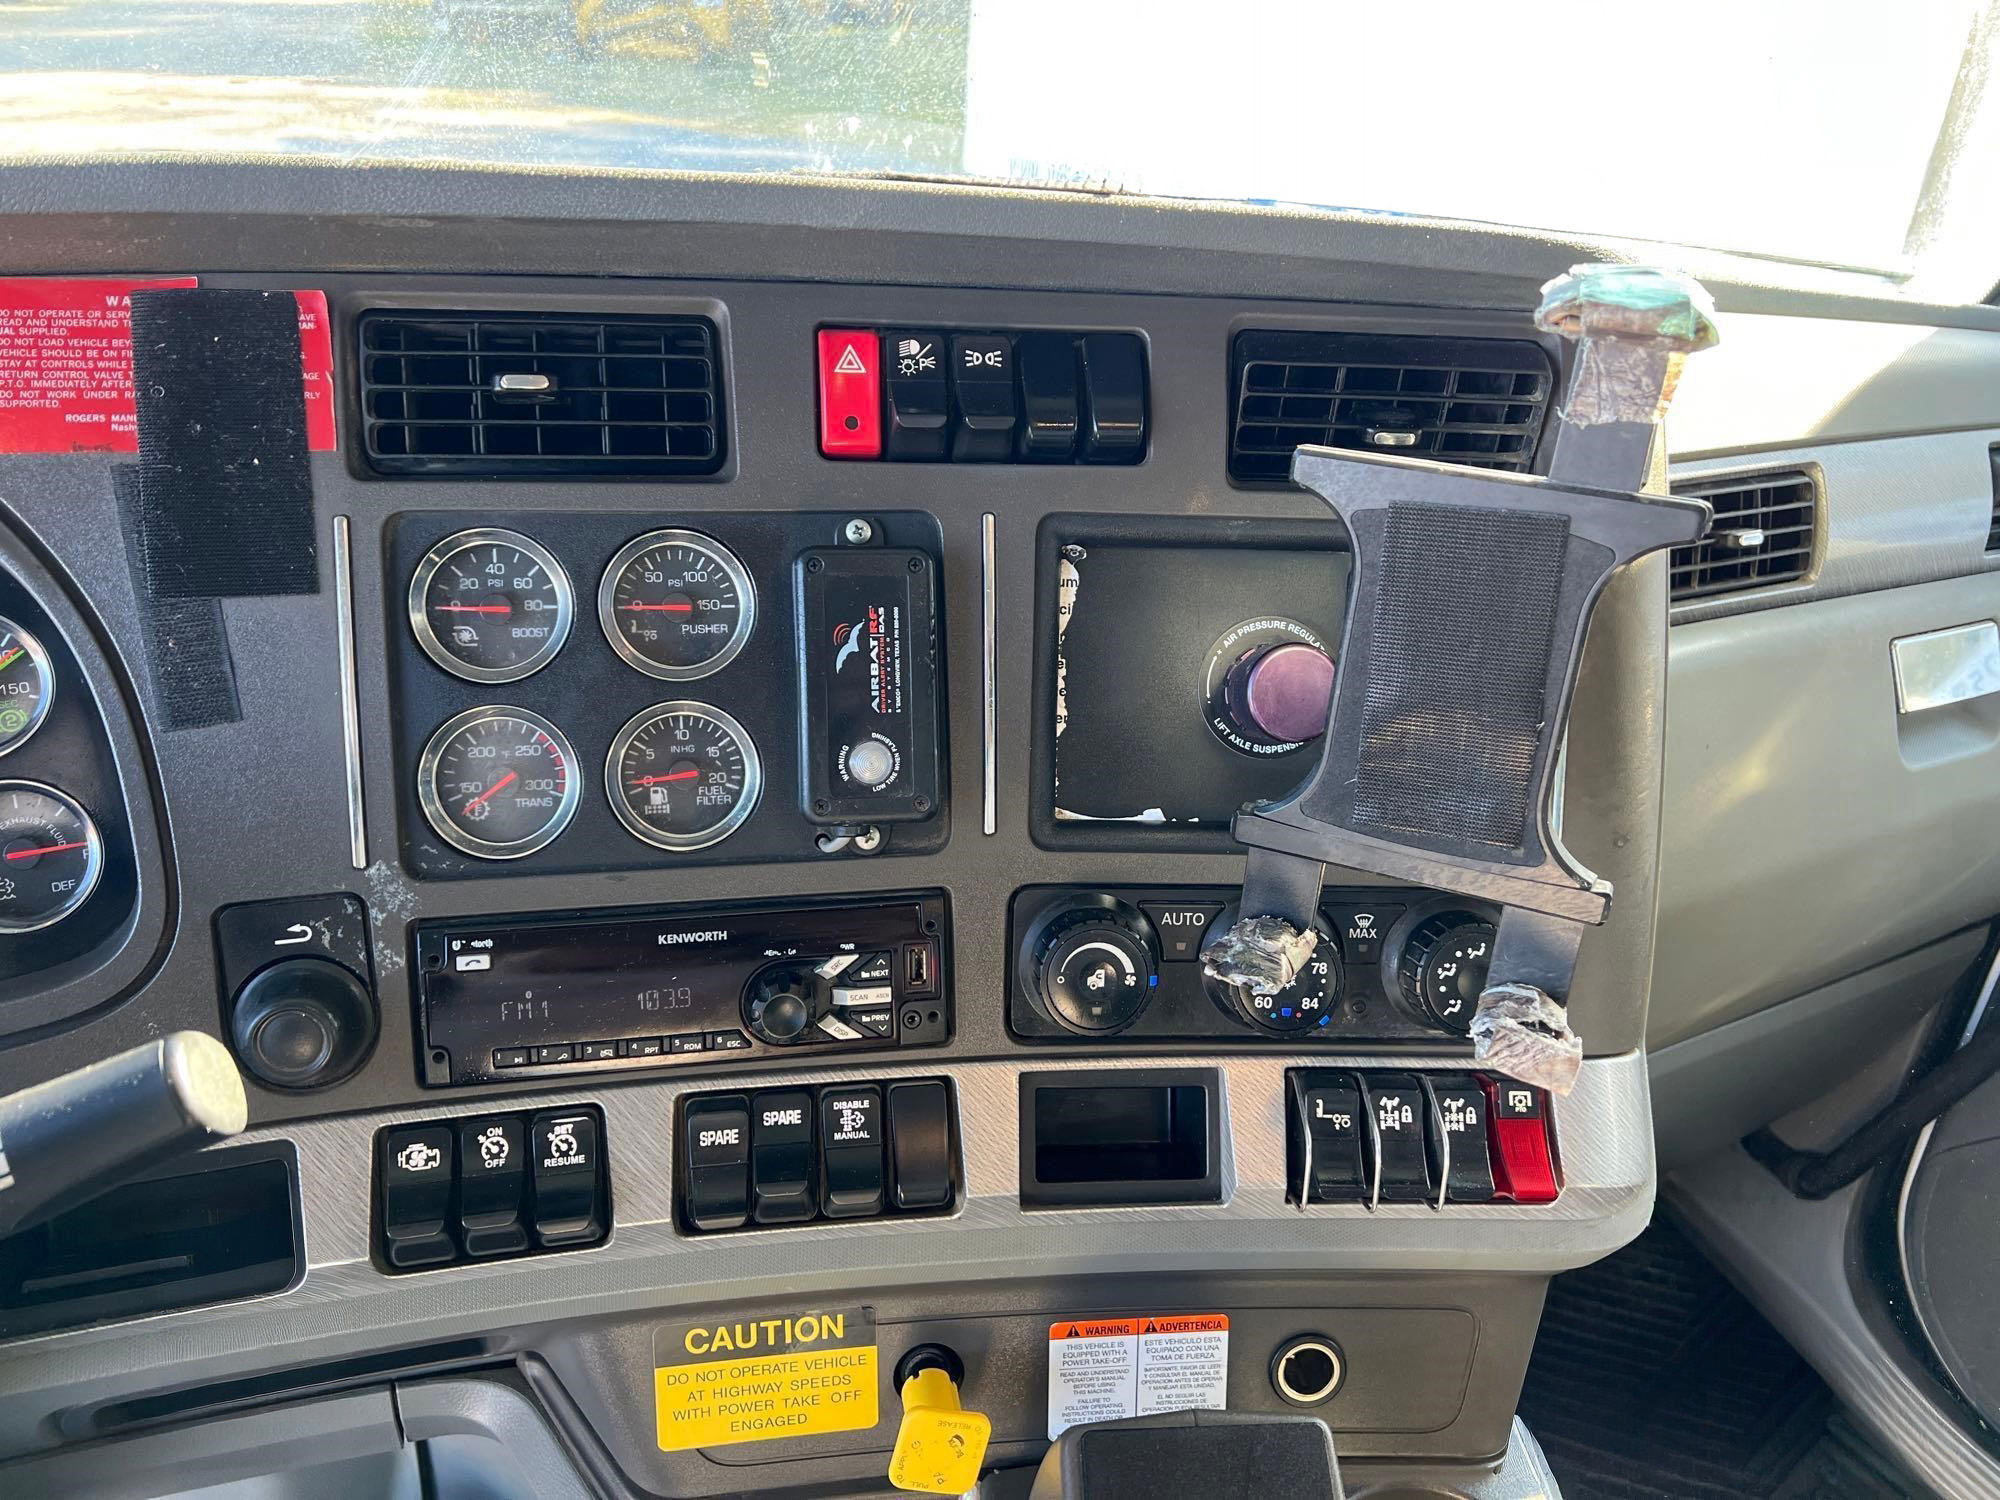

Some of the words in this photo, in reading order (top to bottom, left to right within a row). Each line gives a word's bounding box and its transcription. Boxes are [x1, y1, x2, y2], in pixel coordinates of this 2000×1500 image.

[39, 310, 84, 318] OPERATE
[51, 319, 119, 328] UNDERSTAND
[19, 328, 70, 336] SUPPLIED.
[14, 338, 33, 346] NOT
[38, 338, 64, 346] LOAD
[67, 339, 108, 347] VEHICLE
[42, 349, 82, 357] SHOULD
[41, 360, 94, 368] CONTROLS
[97, 361, 127, 369] WHILE
[43, 371, 89, 379] CONTROL
[94, 371, 123, 379] VALVE
[31, 380, 96, 388] IMMEDIATELY
[101, 380, 132, 388] AFTER
[0, 400, 61, 408] SUPPORTED.
[65, 414, 105, 422] ROGERS
[485, 563, 505, 575] 40
[644, 571, 663, 583] 50
[683, 571, 708, 583] 100
[459, 578, 479, 591] 20
[487, 579, 504, 588] PSI
[513, 577, 533, 590] 60
[668, 579, 683, 588] PSI
[524, 600, 543, 612] 80
[697, 600, 720, 612] 150
[512, 627, 550, 638] BOOST
[681, 624, 729, 635] PUSHER
[1223, 633, 1238, 648] AIR
[1237, 620, 1287, 637] PRESSURE
[869, 637, 880, 714] AIRBAT
[673, 730, 690, 741] 10
[1214, 717, 1231, 736] LIFT
[1228, 733, 1251, 750] AXLE
[871, 732, 898, 752] FLASHING
[467, 746, 496, 758] 200
[515, 745, 541, 757] 250
[645, 749, 655, 760] 5
[706, 746, 720, 758] 15
[838, 744, 850, 782] WARNING
[893, 752, 901, 771] WHEN
[708, 772, 727, 784] 20
[885, 772, 898, 785] TIRE
[458, 782, 482, 794] 150
[524, 779, 553, 792] 300
[698, 786, 726, 796] FUEL
[872, 782, 886, 792] LOW
[515, 797, 553, 809] TRANS
[696, 795, 732, 806] FILTER
[52, 879, 76, 892] DEF
[1161, 911, 1206, 928] AUTO
[658, 930, 728, 945] KENWORTH
[1349, 928, 1377, 940] MAX
[830, 960, 844, 972] SRC
[1311, 963, 1328, 976] 78
[871, 969, 889, 978] NEXT
[850, 993, 869, 1002] SCAN
[1254, 997, 1273, 1010] 60
[1301, 997, 1320, 1010] 84
[871, 1013, 889, 1021] PREV
[833, 1026, 849, 1037] DISP
[683, 1043, 702, 1051] RDM
[727, 1039, 741, 1048] ESC
[644, 1047, 659, 1055] RPT
[832, 1099, 871, 1111] DISABLE
[762, 1109, 802, 1127] SPARE
[486, 1127, 504, 1138] ON
[553, 1124, 574, 1136] SET
[833, 1129, 871, 1141] MANUAL
[699, 1129, 740, 1147] SPARE
[485, 1158, 506, 1169] OFF
[544, 1155, 586, 1168] RESUME
[1085, 1325, 1130, 1336] WARNING
[1159, 1320, 1222, 1332] ADVERTENCIA
[684, 1314, 844, 1354] CAUTION
[1084, 1342, 1116, 1350] VEHICLE
[1144, 1338, 1163, 1346] ESTE
[1062, 1351, 1100, 1359] EQUIPPED
[1146, 1346, 1184, 1354] EQUIPADO
[1186, 1352, 1215, 1360] FUERZA
[667, 1373, 689, 1386] DO
[695, 1369, 727, 1384] NOT
[730, 1361, 800, 1379] OPERATE
[804, 1354, 868, 1371] VEHICLE
[687, 1390, 706, 1402] AT
[713, 1381, 784, 1398] HIGHWAY
[790, 1374, 852, 1391] SPEEDS
[673, 1406, 712, 1422] WITH
[718, 1400, 774, 1417] POWER
[781, 1394, 821, 1409] TAKE
[830, 1389, 863, 1403] OFF
[730, 1413, 808, 1433] ENGAGED
